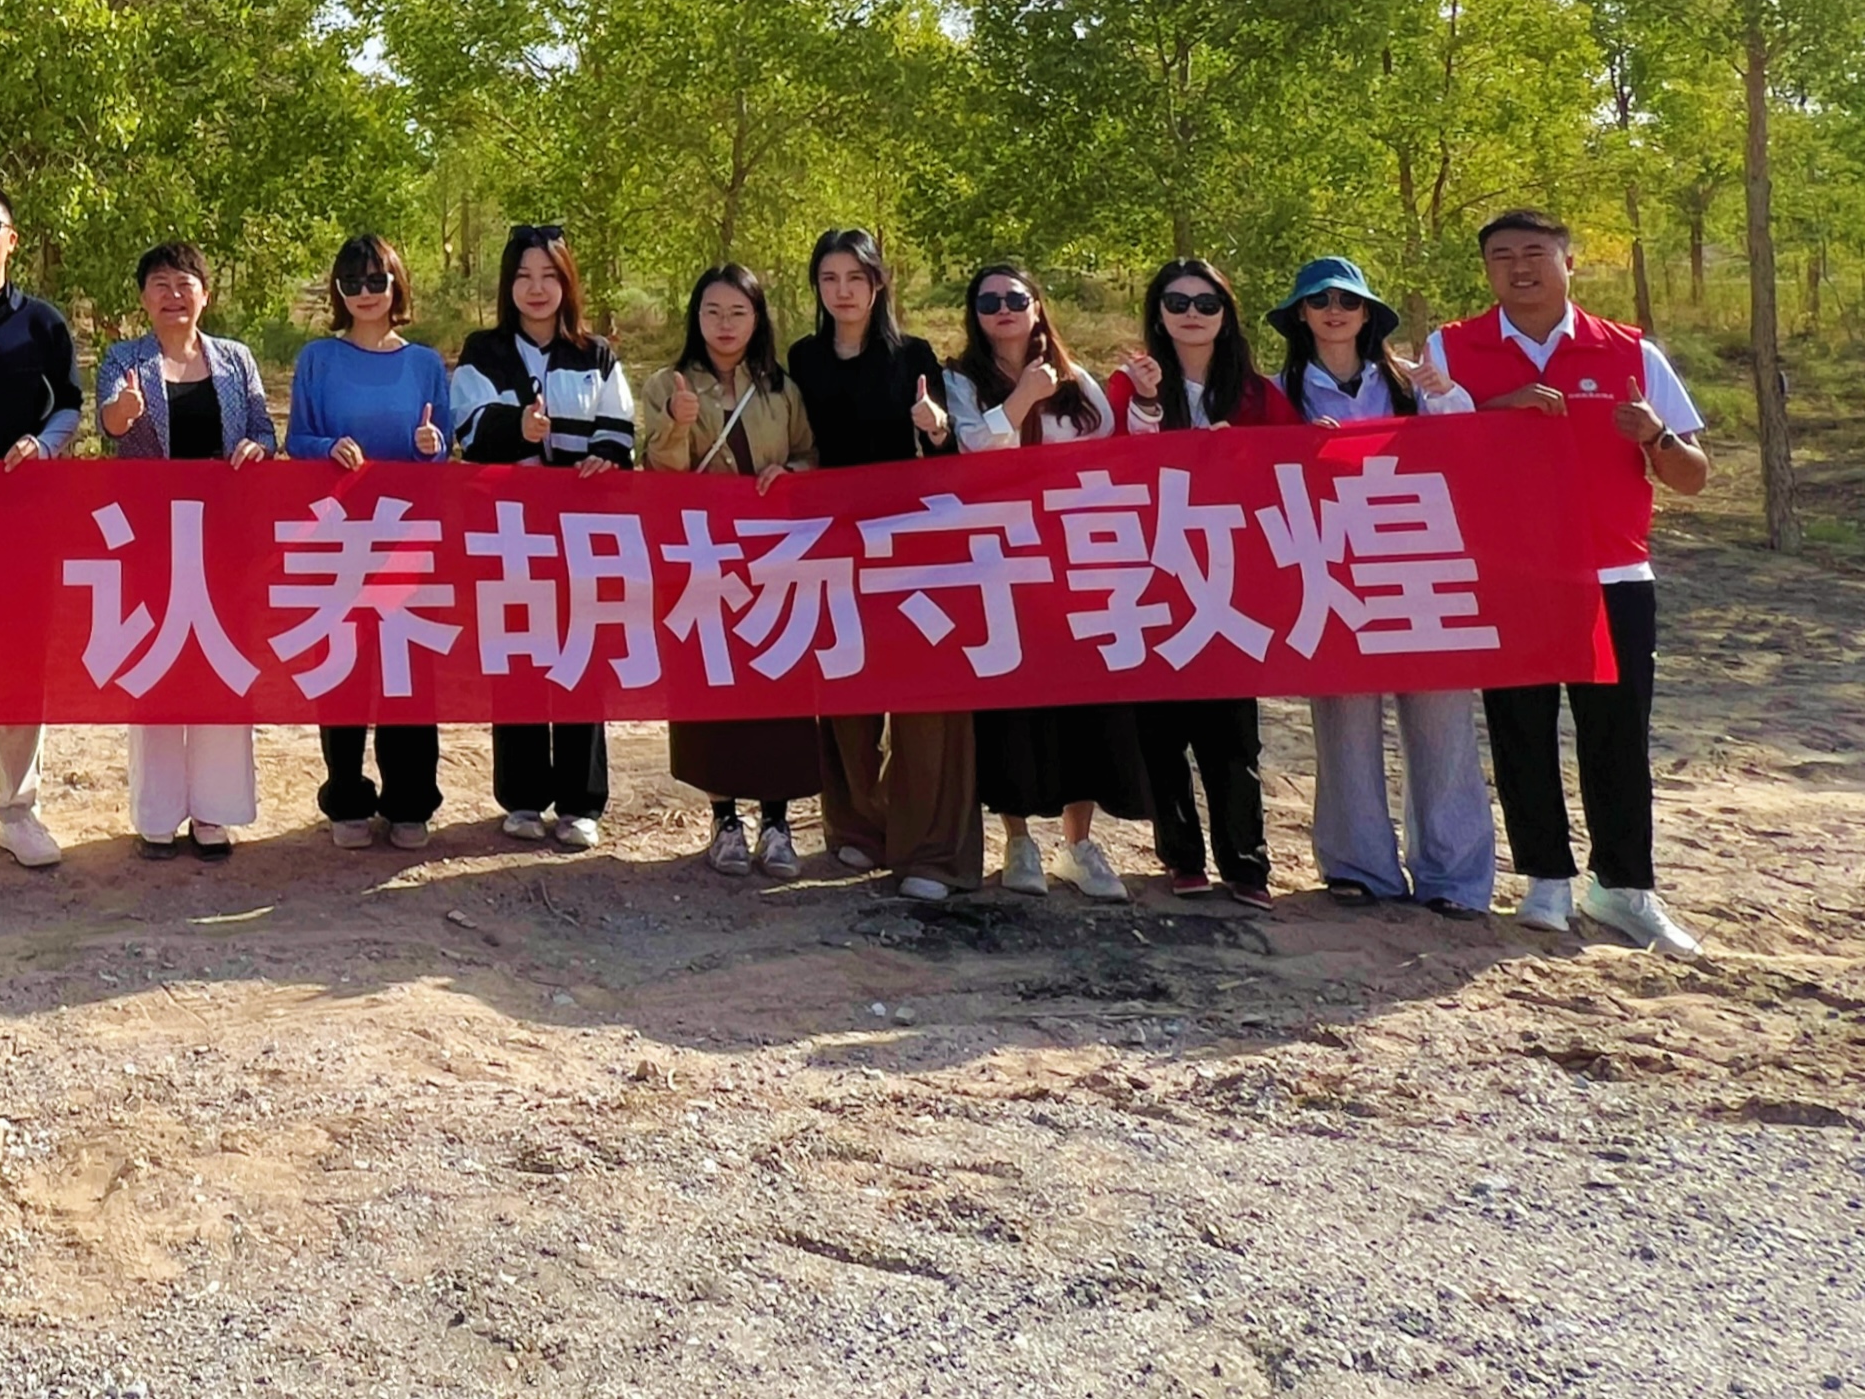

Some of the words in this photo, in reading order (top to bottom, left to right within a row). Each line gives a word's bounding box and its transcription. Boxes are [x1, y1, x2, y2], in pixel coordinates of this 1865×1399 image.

[62, 456, 1501, 699] 认养胡杨守敦煌
